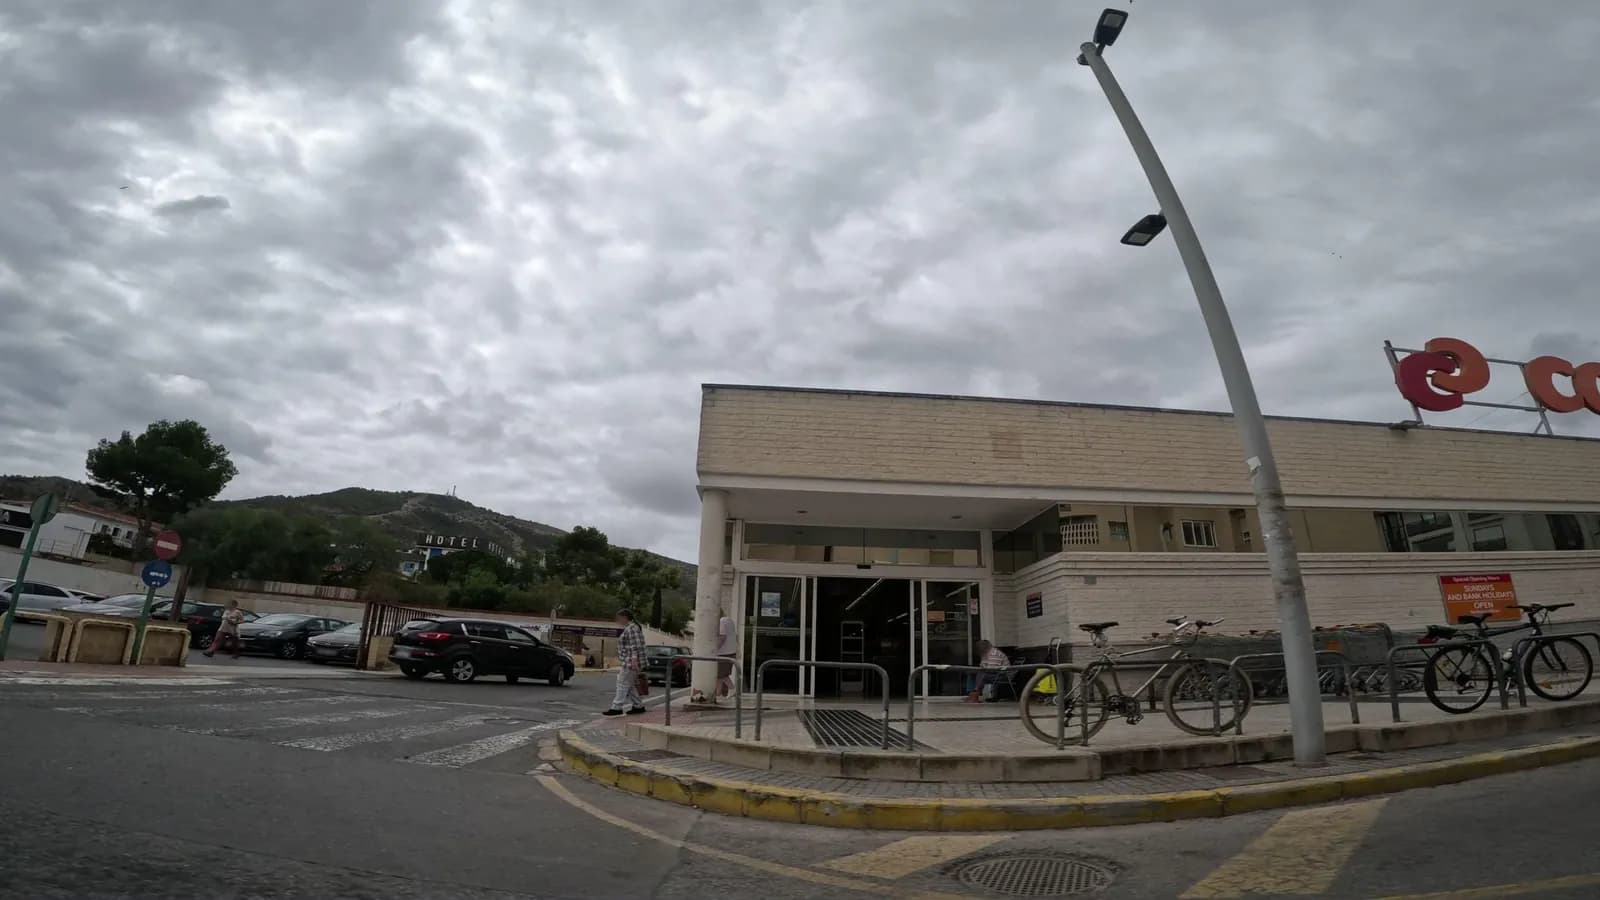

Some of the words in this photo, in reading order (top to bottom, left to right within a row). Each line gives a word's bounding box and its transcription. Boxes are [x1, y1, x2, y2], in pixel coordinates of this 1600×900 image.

[425, 534, 478, 548] HOTEL
[1463, 584, 1494, 592] SUNDAYS
[1447, 593, 1462, 601] AND
[1462, 592, 1481, 600] BANK
[1482, 591, 1514, 599] HOLIDAYS
[1473, 601, 1494, 609] OPEN
